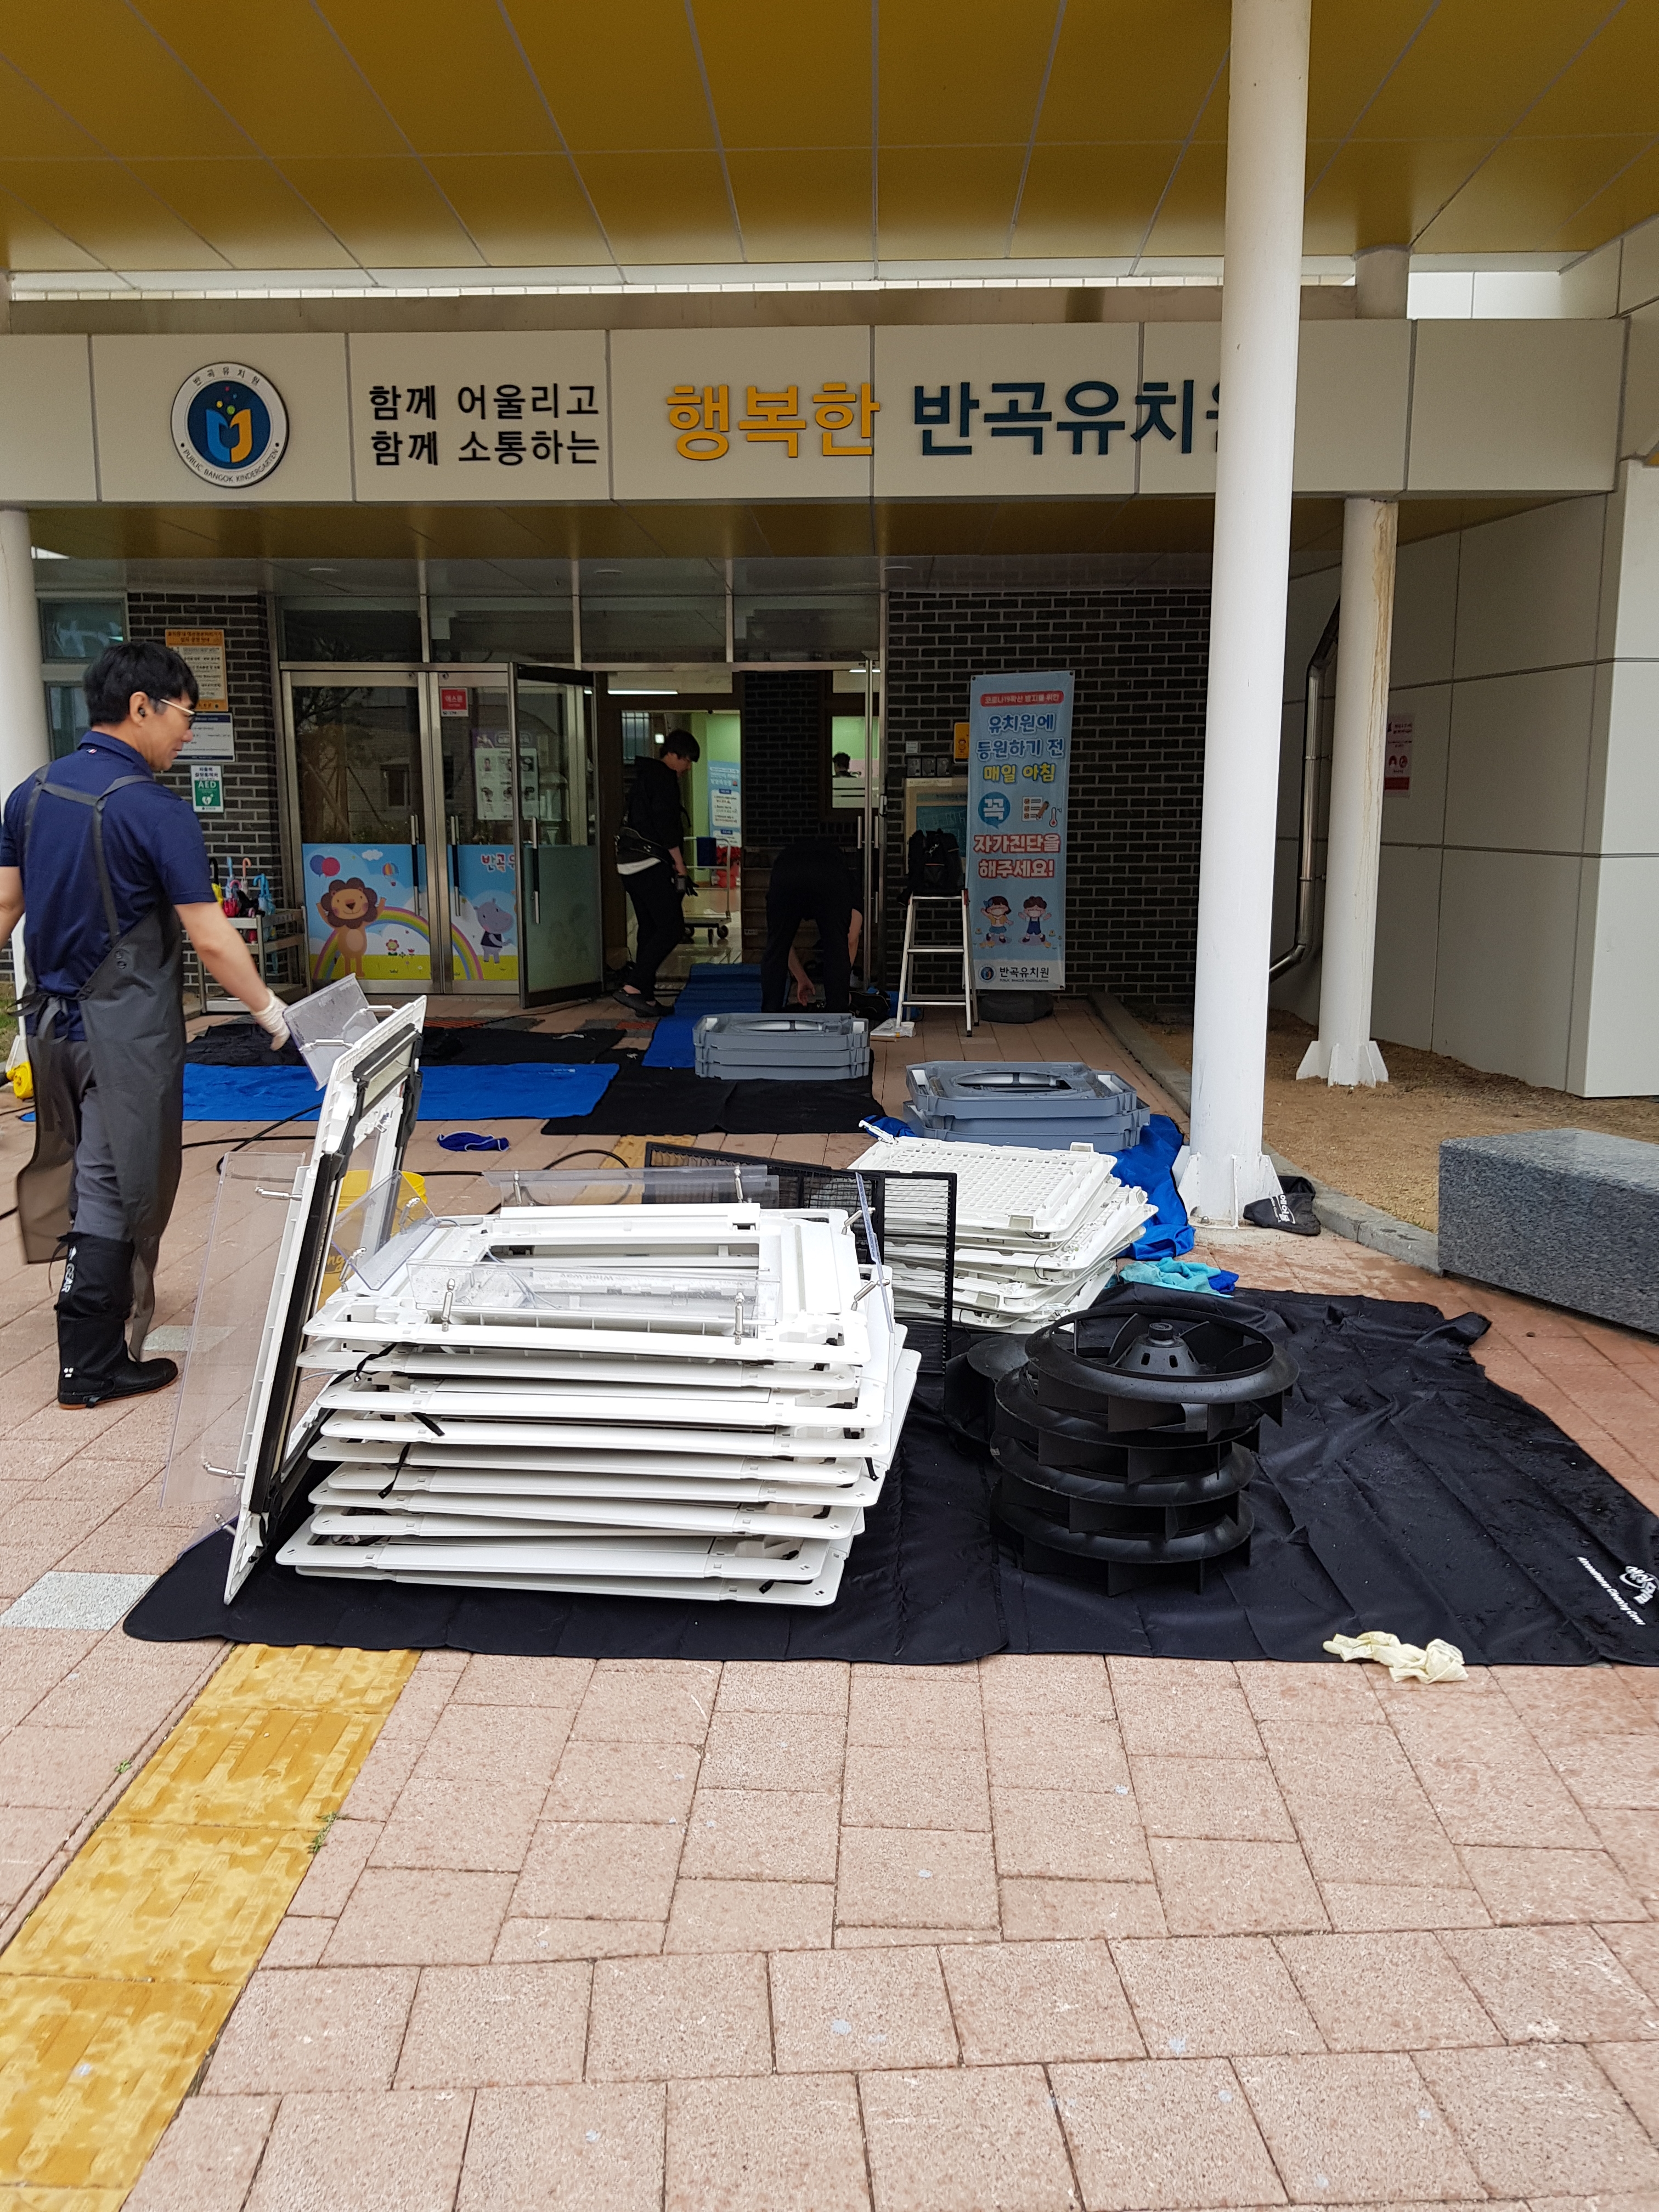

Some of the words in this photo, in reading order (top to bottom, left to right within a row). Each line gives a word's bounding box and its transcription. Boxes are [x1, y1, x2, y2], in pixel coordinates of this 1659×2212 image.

[369, 385, 437, 420] 함께
[458, 382, 600, 420] 어울리고
[667, 381, 881, 461] 행복한
[913, 379, 1218, 456] 반곡유치
[371, 430, 438, 466] 함께
[458, 428, 600, 466] 소통하는
[183, 449, 202, 471] PUBLIC
[204, 467, 234, 482] BANGOK
[989, 714, 1054, 734] 유치원에
[977, 740, 1041, 760] 등원하기
[1048, 738, 1064, 758] 전
[984, 765, 1015, 783] 매일
[1022, 763, 1056, 782] 아침
[198, 781, 217, 789] AED
[983, 798, 1005, 821] 꼭
[973, 833, 1061, 853] 자가진단을
[978, 859, 1054, 878] 해주세요!
[1000, 966, 1049, 978] 반곡유치원
[61, 1262, 75, 1293] GEAR
